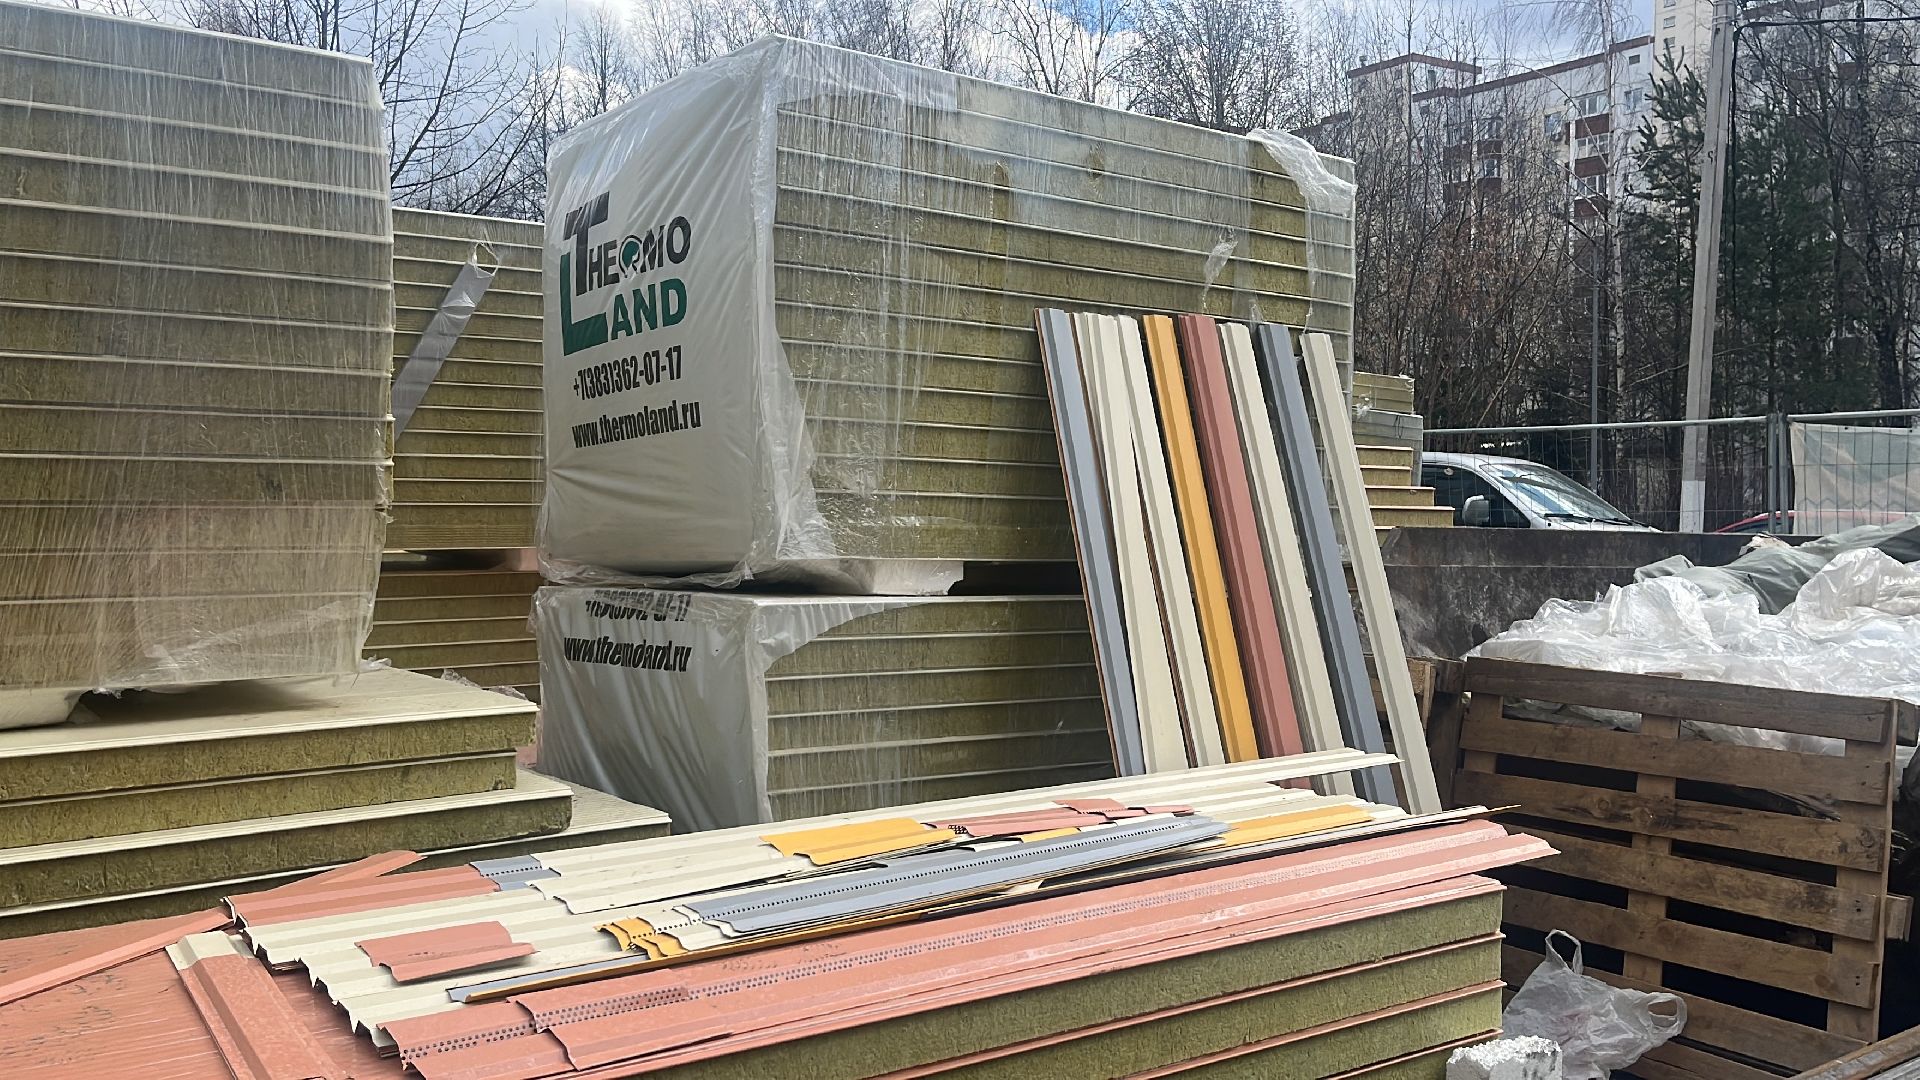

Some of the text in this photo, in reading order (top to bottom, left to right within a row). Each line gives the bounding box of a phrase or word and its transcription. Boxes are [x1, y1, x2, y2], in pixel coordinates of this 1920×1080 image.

[559, 252, 688, 357] LAND
[573, 345, 682, 400] +7(383)362-07-17
[571, 400, 702, 448] www.thermoland.ru
